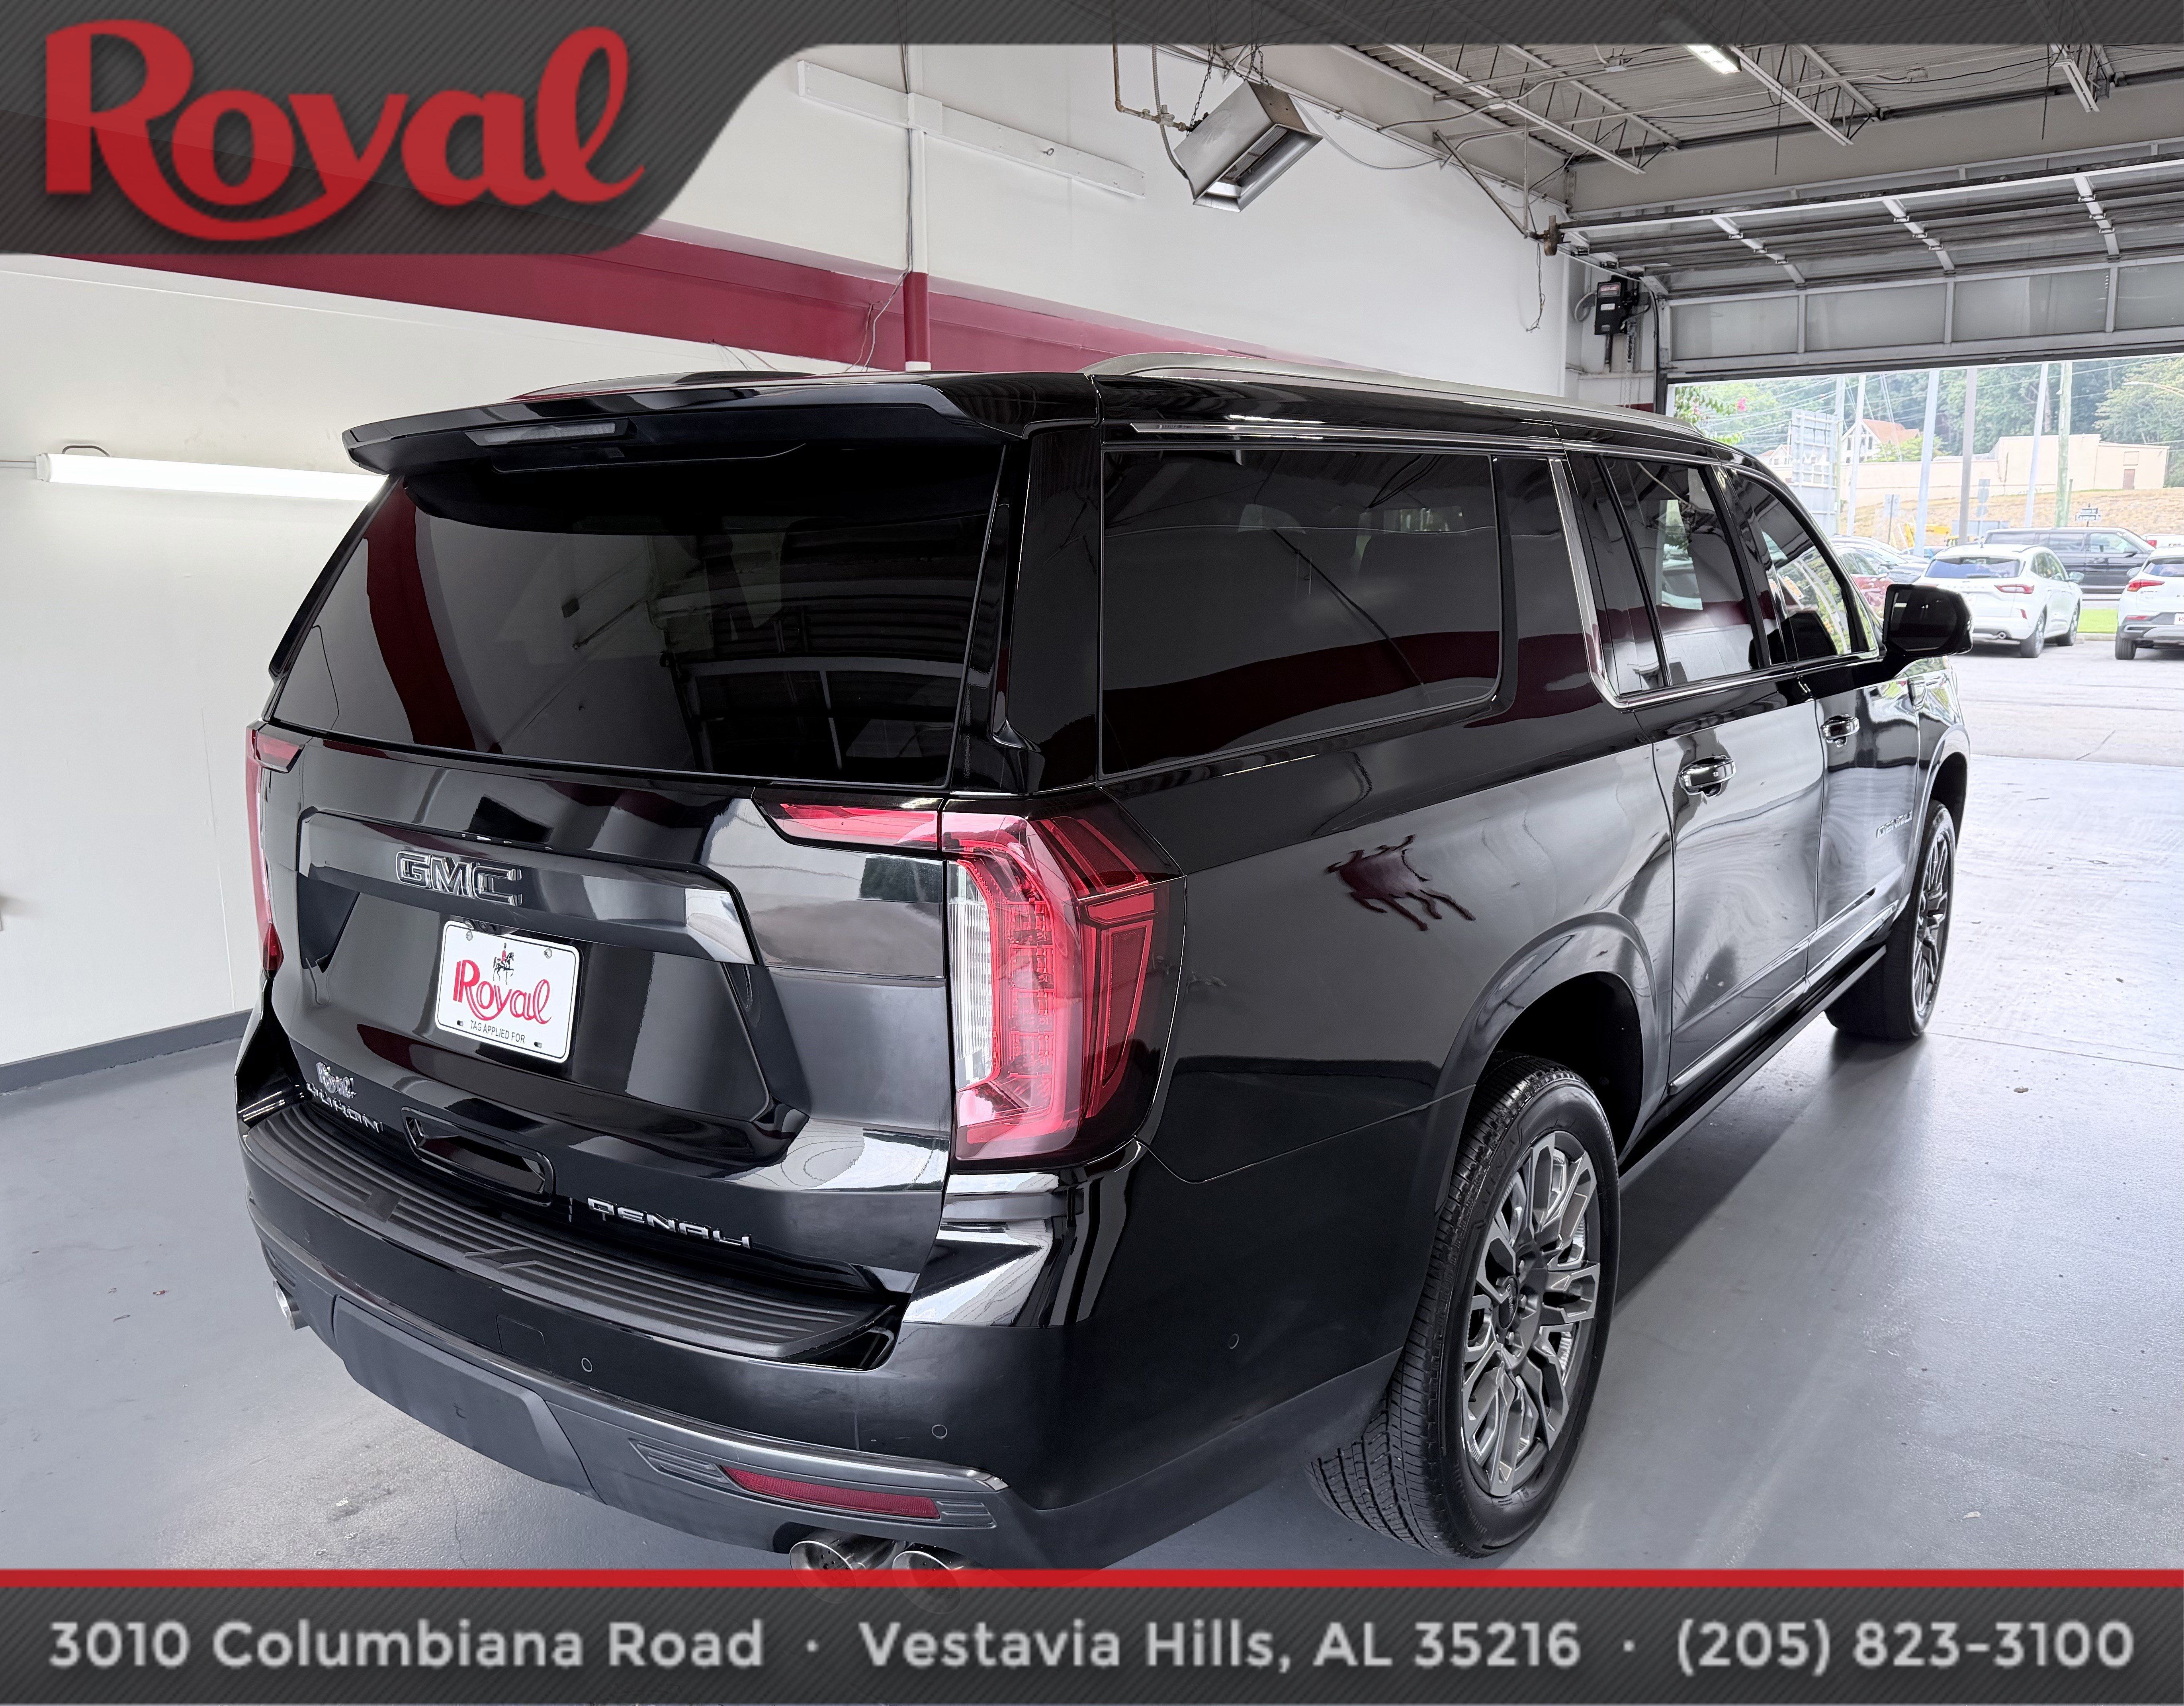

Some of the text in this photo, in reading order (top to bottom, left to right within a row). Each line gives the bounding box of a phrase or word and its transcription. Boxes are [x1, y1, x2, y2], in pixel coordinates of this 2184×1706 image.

[396, 850, 522, 906] GMC
[453, 959, 551, 1025] Royal
[470, 1020, 525, 1044] TAG APPLIED FOR
[588, 1196, 752, 1249] DENALI
